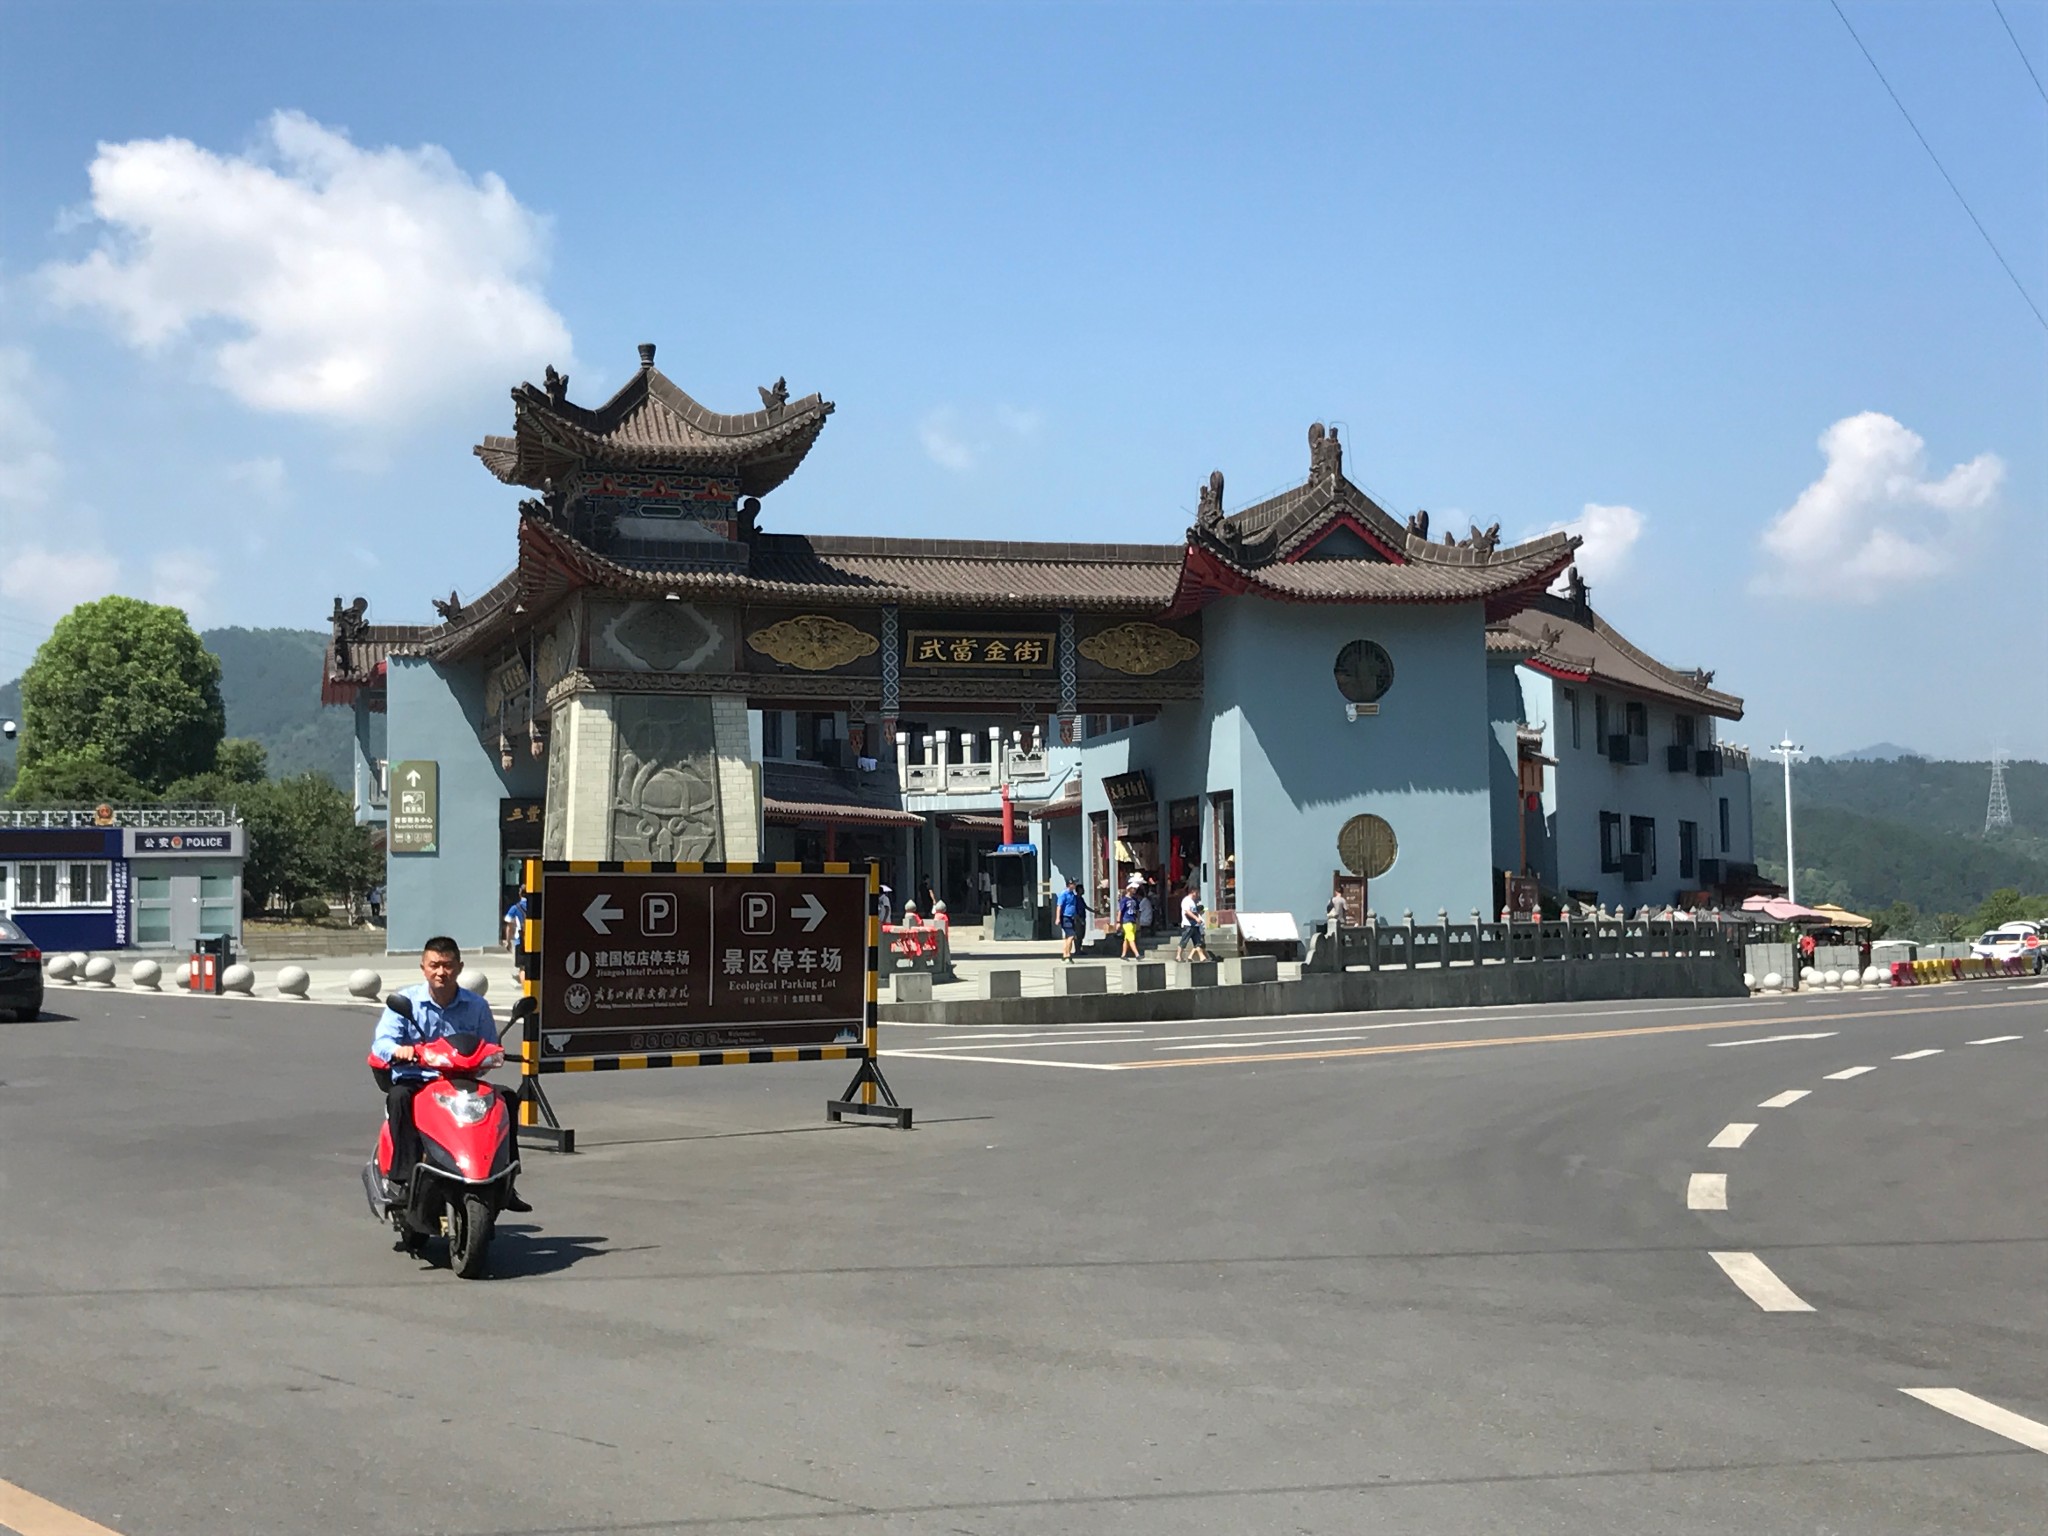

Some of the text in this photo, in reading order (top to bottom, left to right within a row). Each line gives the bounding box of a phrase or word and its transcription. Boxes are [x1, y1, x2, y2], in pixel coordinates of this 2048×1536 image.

[919, 639, 1043, 662] 武當金街
[144, 837, 169, 848] 公安
[186, 837, 223, 847] POLICE
[648, 898, 670, 930] P
[748, 897, 768, 929] P
[595, 950, 690, 968] 建国饭店停车场
[722, 947, 842, 975] 景区停车场
[596, 967, 689, 978] Jianguo Hotel Parking Lot
[729, 978, 836, 991] Ecological Parking Lot
